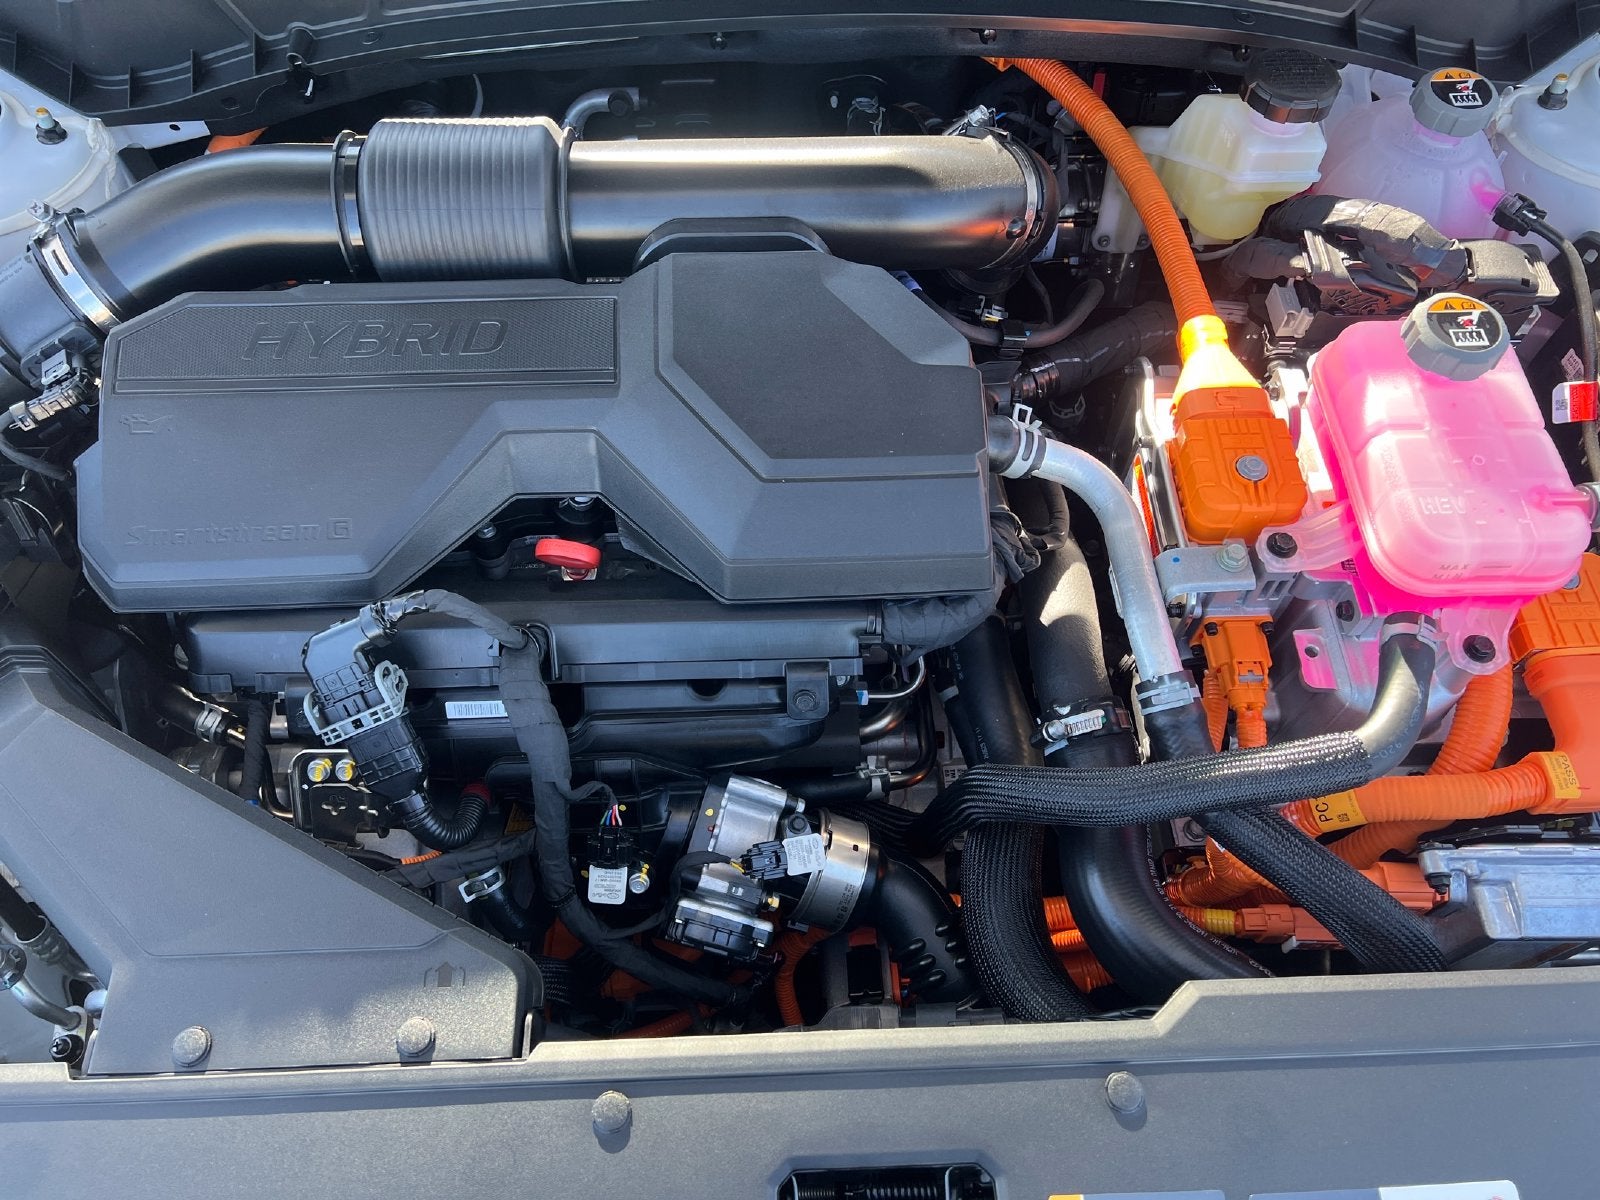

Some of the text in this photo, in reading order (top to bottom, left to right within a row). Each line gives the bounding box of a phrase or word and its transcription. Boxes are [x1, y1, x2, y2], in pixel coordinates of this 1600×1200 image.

[241, 318, 509, 360] HYBRID
[1419, 496, 1467, 514] HEV
[124, 519, 351, 547] Smartstream G
[1432, 572, 1463, 580] MIN
[1439, 563, 1470, 571] MAX
[1558, 755, 1577, 786] PASS
